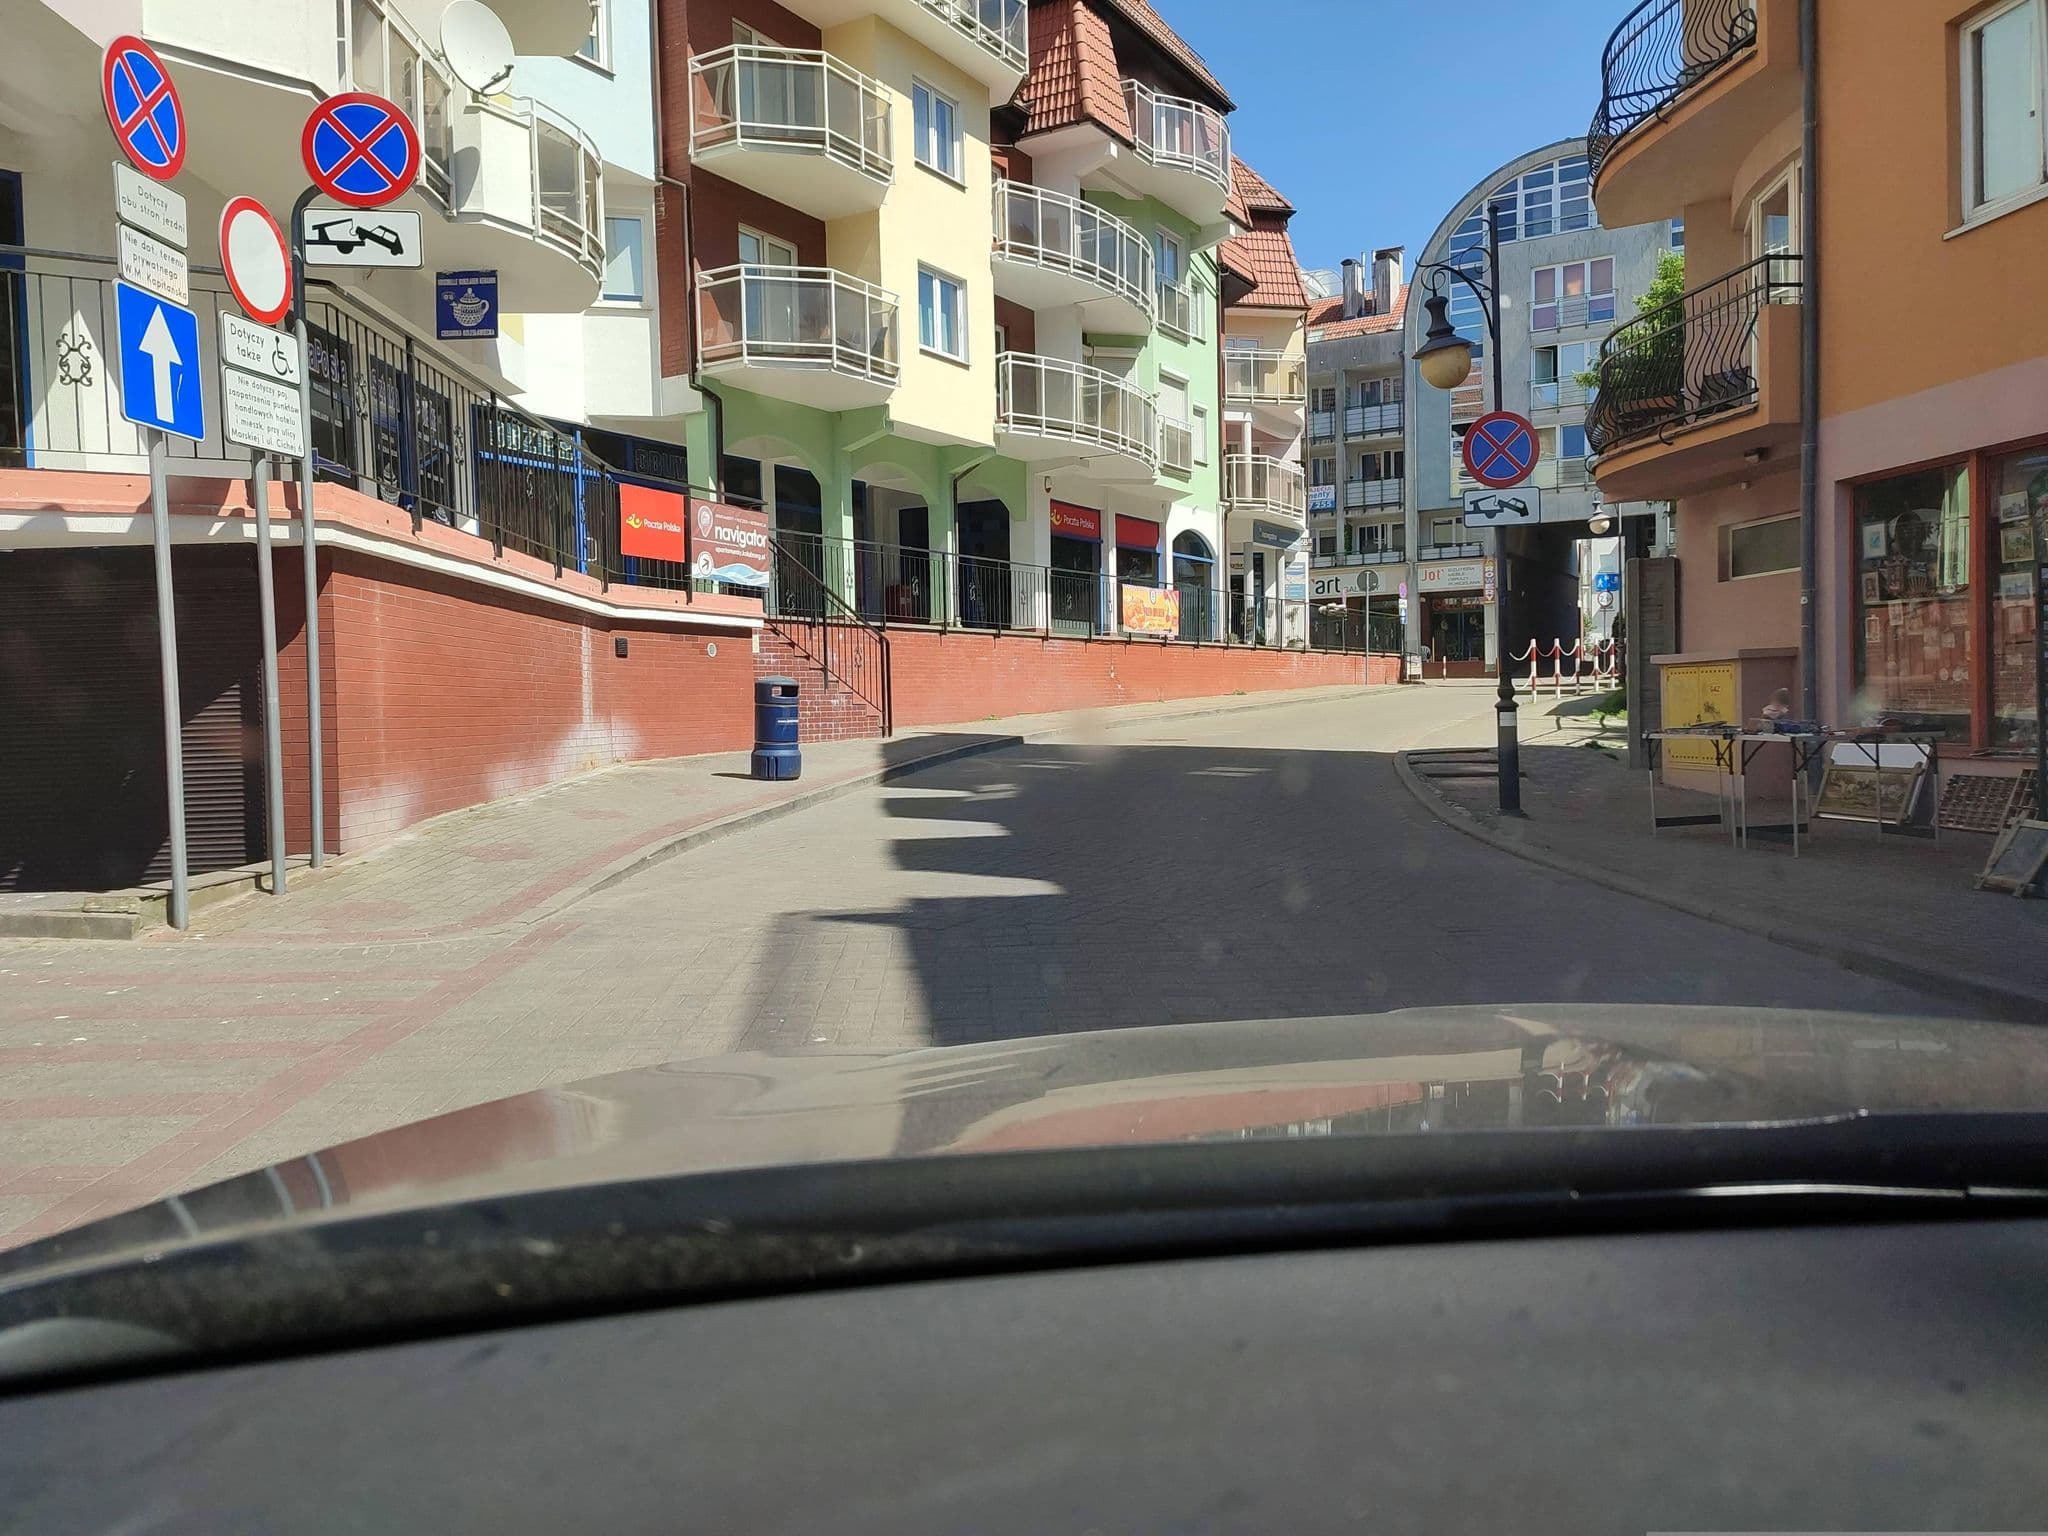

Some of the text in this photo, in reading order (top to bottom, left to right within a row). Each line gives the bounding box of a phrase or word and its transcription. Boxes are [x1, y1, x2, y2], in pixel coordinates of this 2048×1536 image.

[138, 185, 168, 211] Dotyczy
[121, 195, 185, 233] obu stron jezdni
[125, 231, 138, 246] Nie
[160, 249, 183, 268] terenu
[133, 253, 178, 280] prywatnego
[230, 322, 265, 348] Dotyczy
[237, 344, 262, 362] także
[238, 376, 250, 386] Nie
[252, 380, 275, 396] dotyczy
[229, 389, 271, 406] zaopatrzenia
[235, 400, 274, 420] handlowych
[276, 413, 296, 426] hotelu
[231, 427, 260, 445] Morskiej
[267, 426, 280, 437] przy
[282, 428, 296, 440] ulicy
[643, 518, 681, 533] Poczta Polska
[1063, 514, 1095, 530] Poczta Polska
[714, 525, 767, 548] navigator
